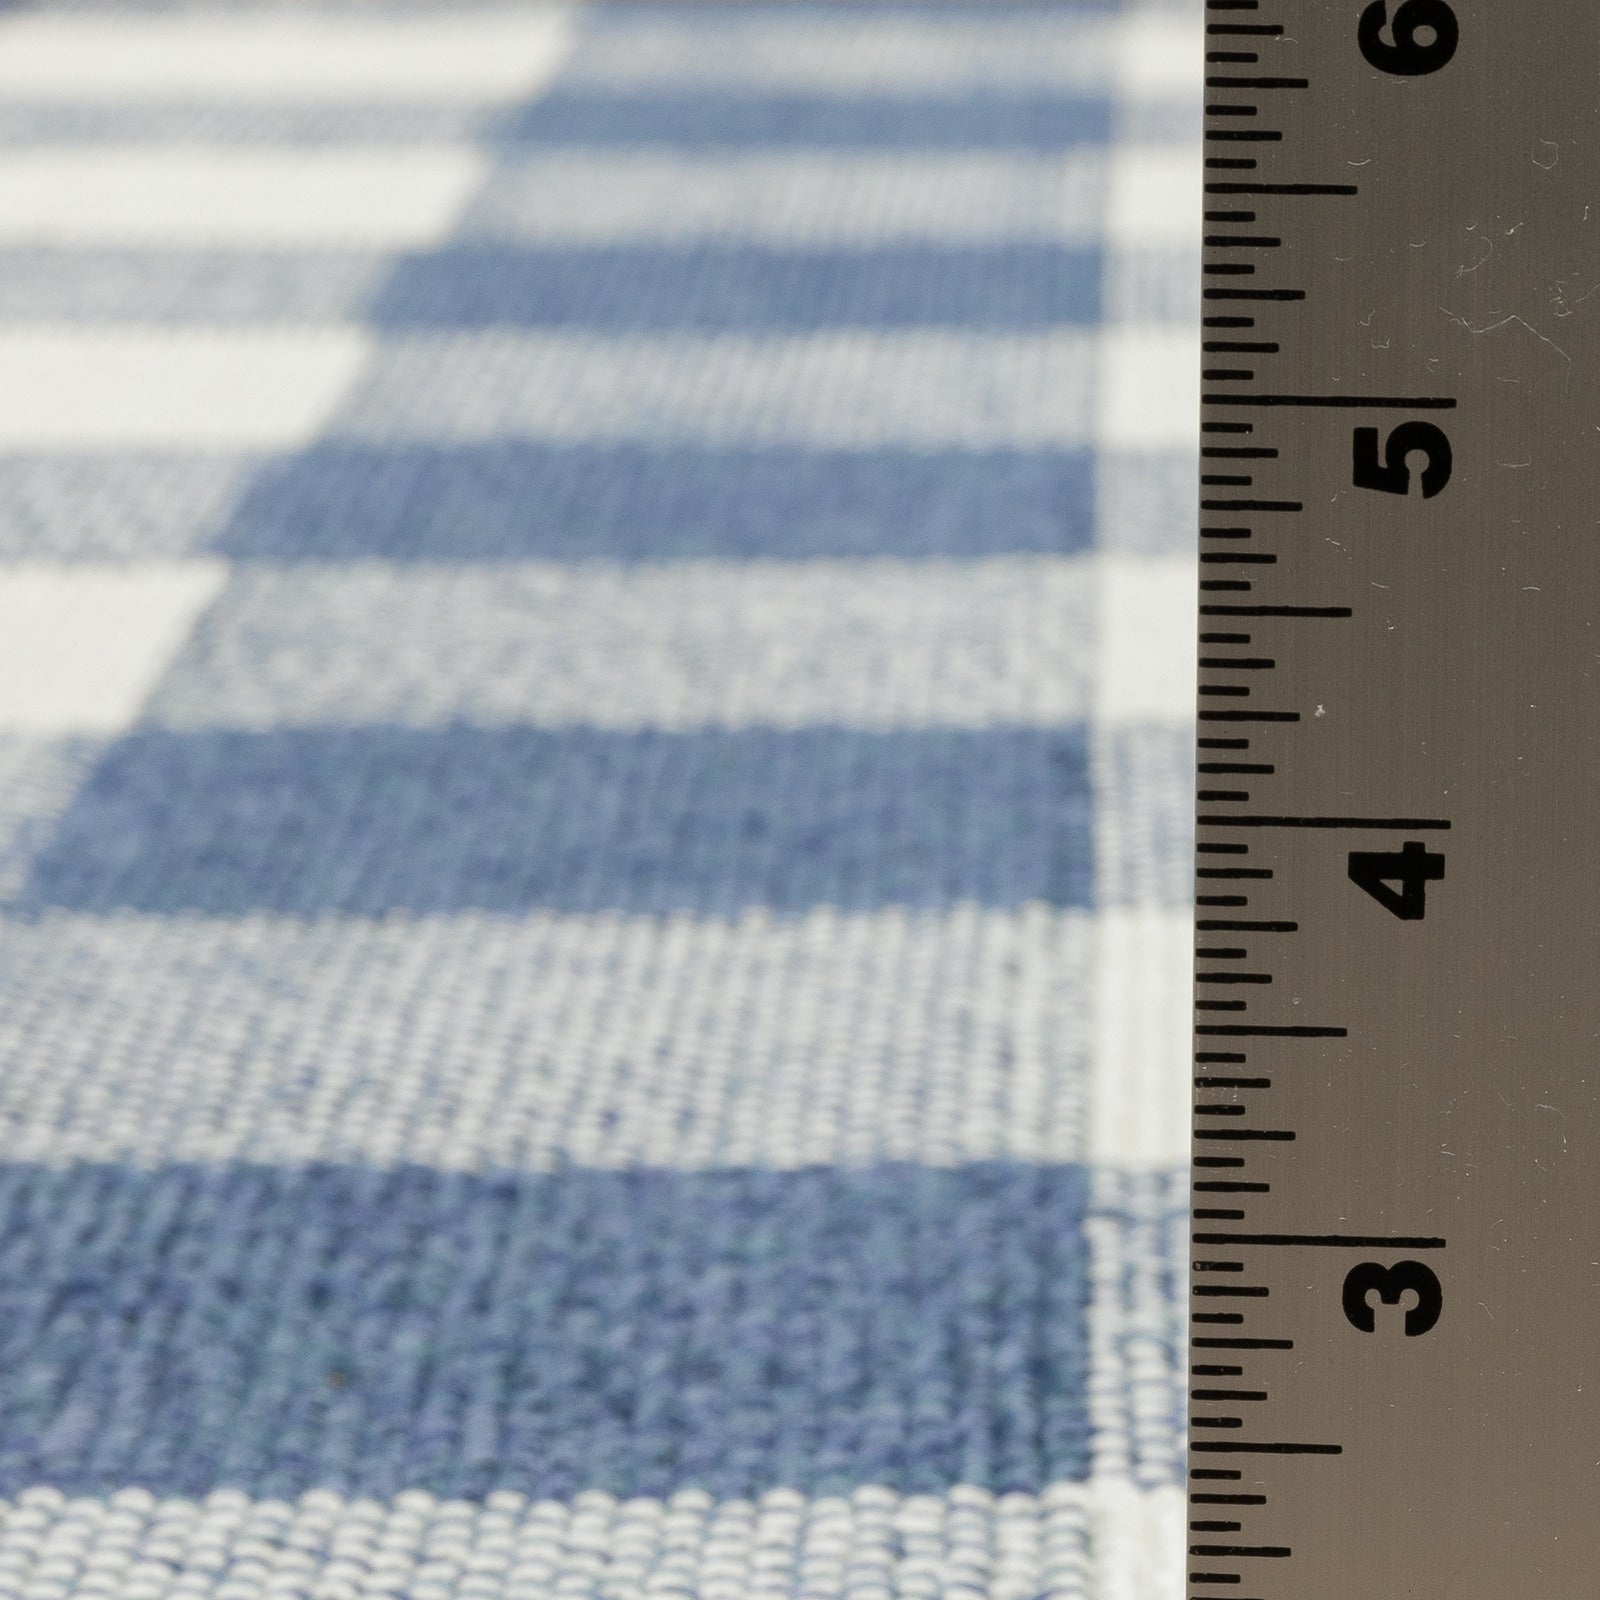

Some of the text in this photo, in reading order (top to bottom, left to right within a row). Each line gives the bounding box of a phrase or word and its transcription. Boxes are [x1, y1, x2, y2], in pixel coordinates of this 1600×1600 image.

[1356, 0, 1460, 77] 6
[1352, 420, 1453, 500] 5
[1347, 840, 1446, 922] 4
[1341, 1259, 1443, 1337] 3
